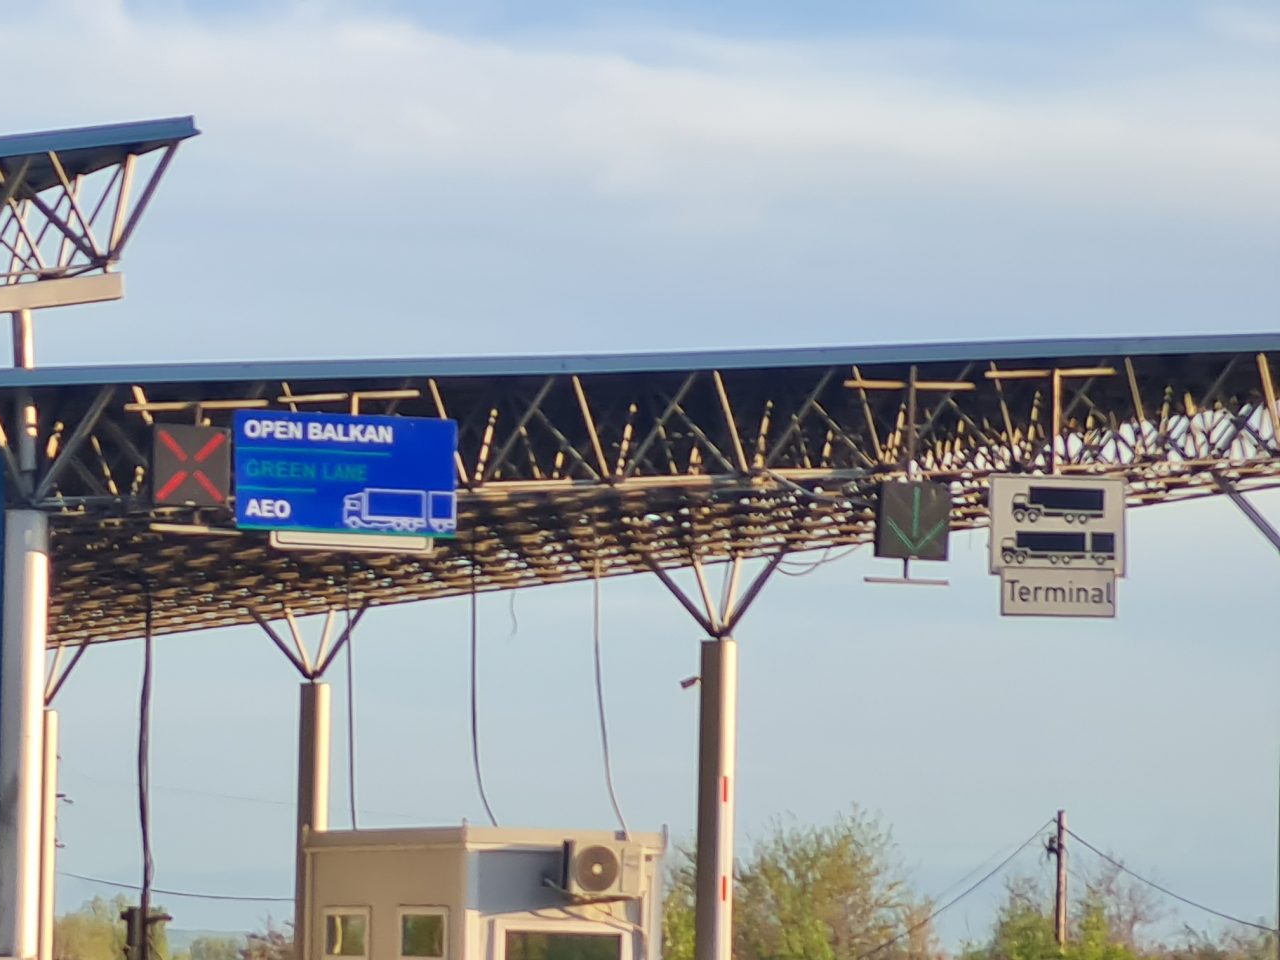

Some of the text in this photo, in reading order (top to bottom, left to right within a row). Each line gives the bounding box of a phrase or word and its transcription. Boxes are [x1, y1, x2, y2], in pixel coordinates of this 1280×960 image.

[243, 419, 394, 444] OPEN BALKAN
[245, 459, 368, 481] GREEN LANE
[245, 499, 291, 519] AEO
[1005, 578, 1113, 604] Terminal
